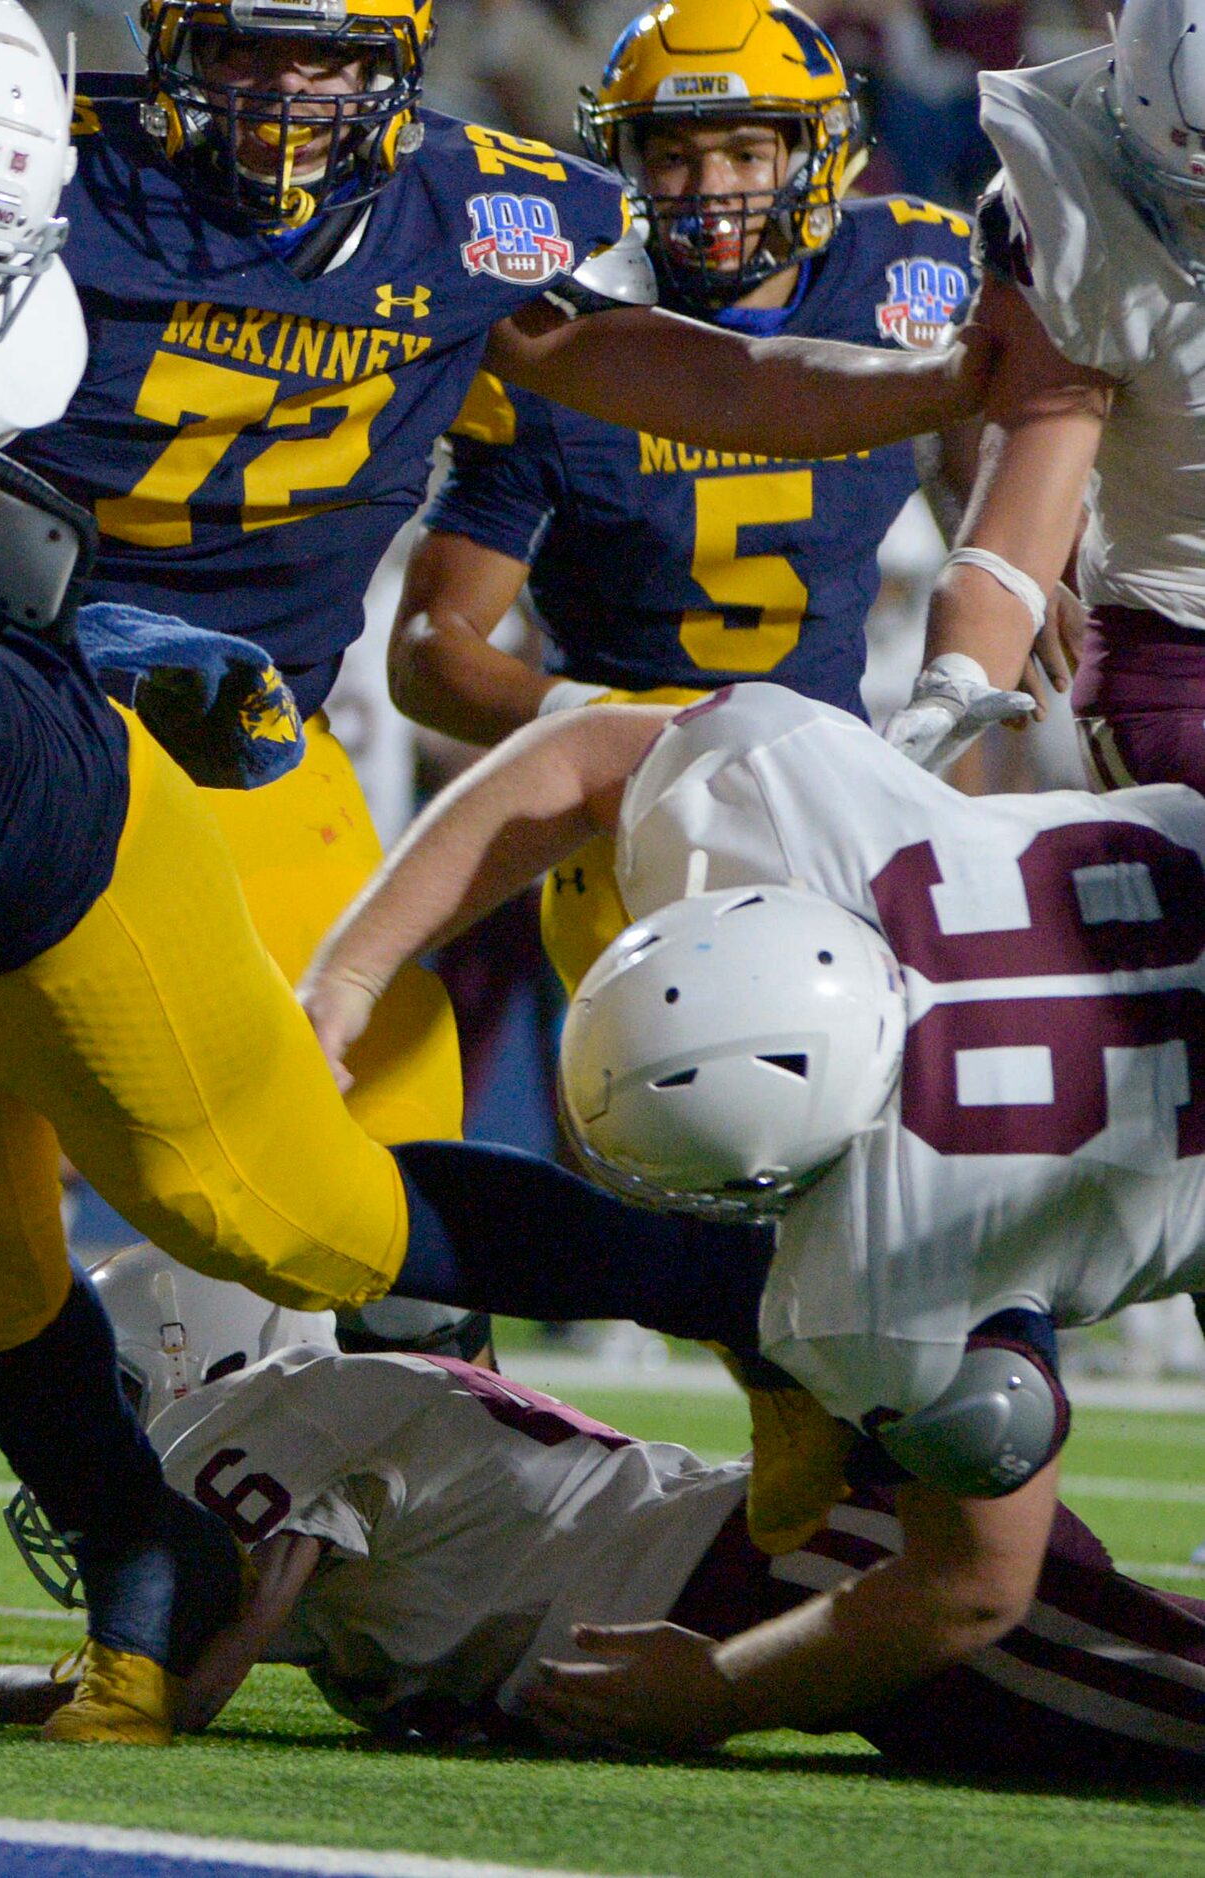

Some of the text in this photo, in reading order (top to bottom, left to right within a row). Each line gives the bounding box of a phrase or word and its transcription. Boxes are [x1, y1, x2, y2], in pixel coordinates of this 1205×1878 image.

[463, 124, 567, 182] 72
[471, 195, 556, 240] 100
[888, 199, 970, 237] 5
[891, 261, 964, 304] 100
[94, 349, 396, 547] 72
[679, 469, 813, 673] 5
[195, 1448, 291, 1544] 6
